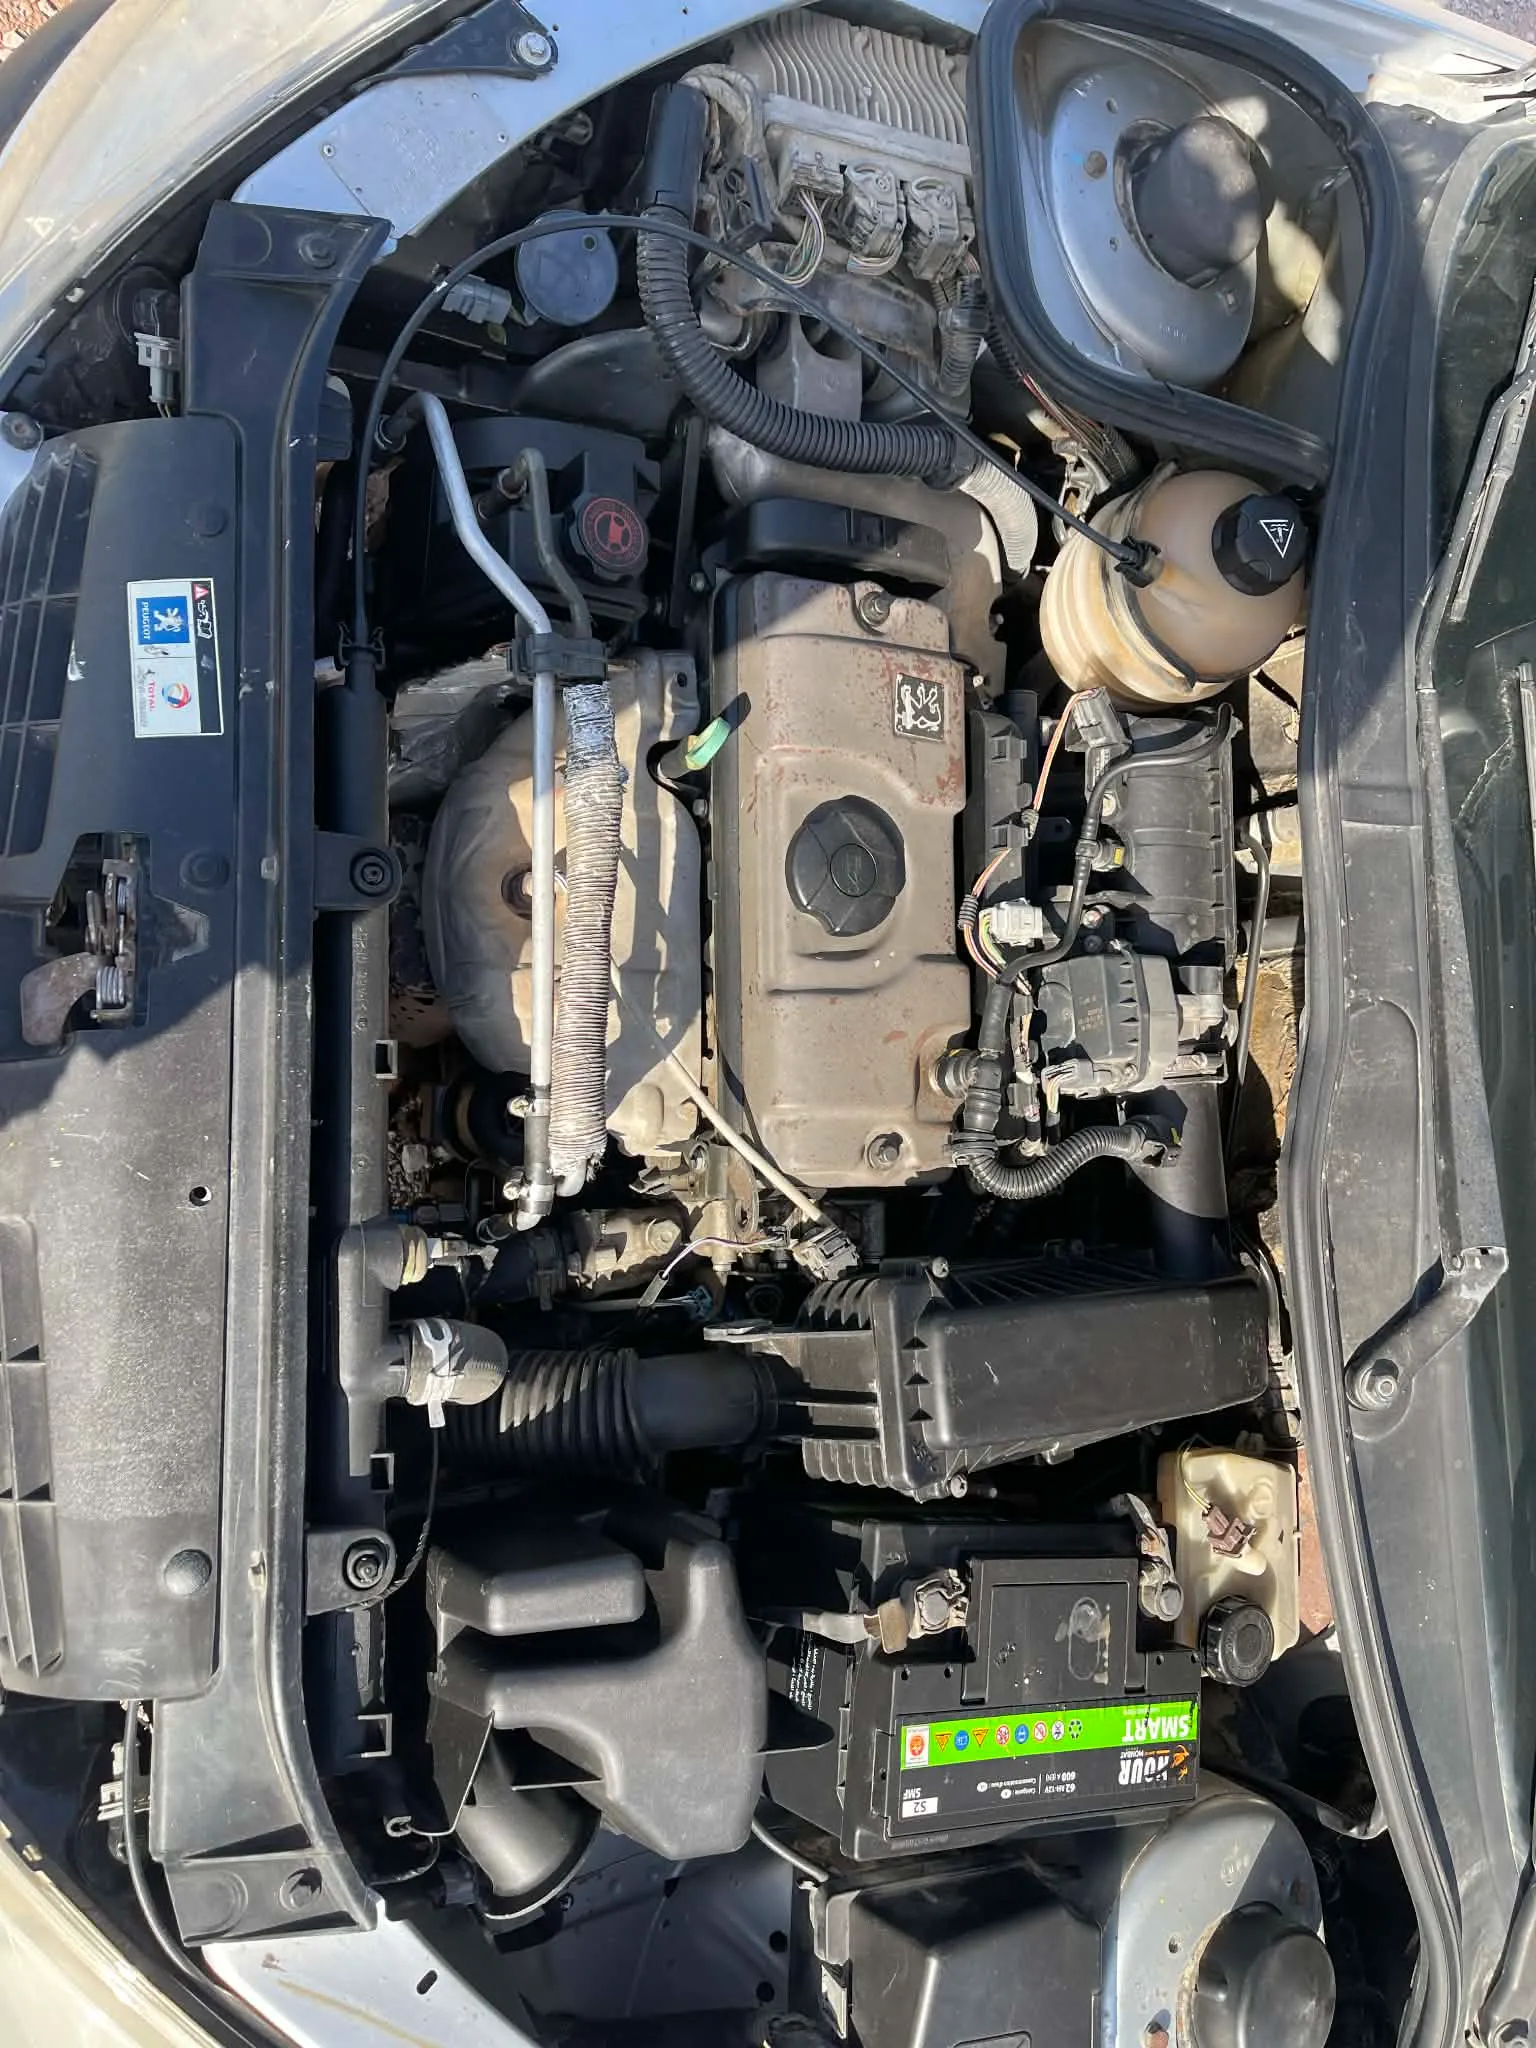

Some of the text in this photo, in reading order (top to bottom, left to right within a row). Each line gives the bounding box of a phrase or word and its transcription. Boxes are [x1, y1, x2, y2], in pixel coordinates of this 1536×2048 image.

[141, 601, 152, 641] PEUGEOT
[147, 680, 156, 712] TOTAL
[1122, 1715, 1190, 1742] SMART
[1061, 1771, 1076, 1781] 600
[1065, 1783, 1076, 1793] 62
[913, 1801, 927, 1814] S2
